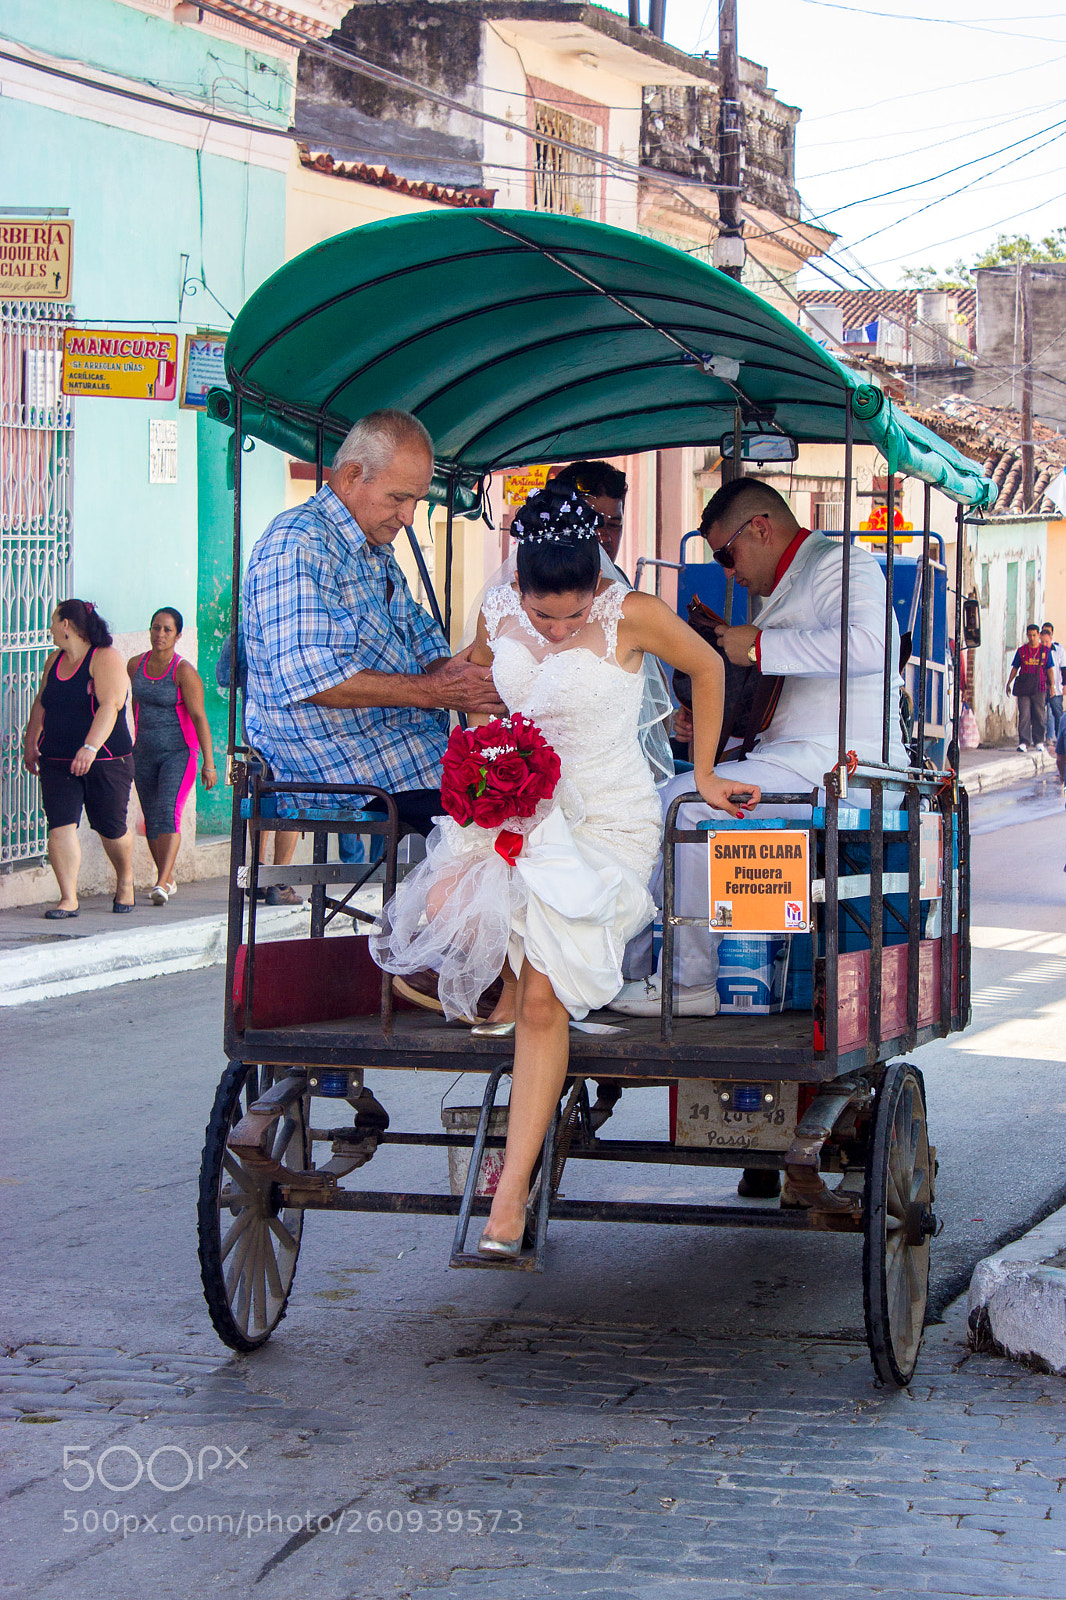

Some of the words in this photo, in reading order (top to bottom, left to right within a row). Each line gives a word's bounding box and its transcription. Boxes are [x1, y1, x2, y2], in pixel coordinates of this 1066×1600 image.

[1, 263, 46, 277] CIALES
[69, 337, 171, 359] MANICURE
[714, 844, 757, 859] SANTA
[760, 844, 802, 859] CLARA
[734, 866, 783, 880] Piquera
[725, 881, 792, 894] Ferrocarril
